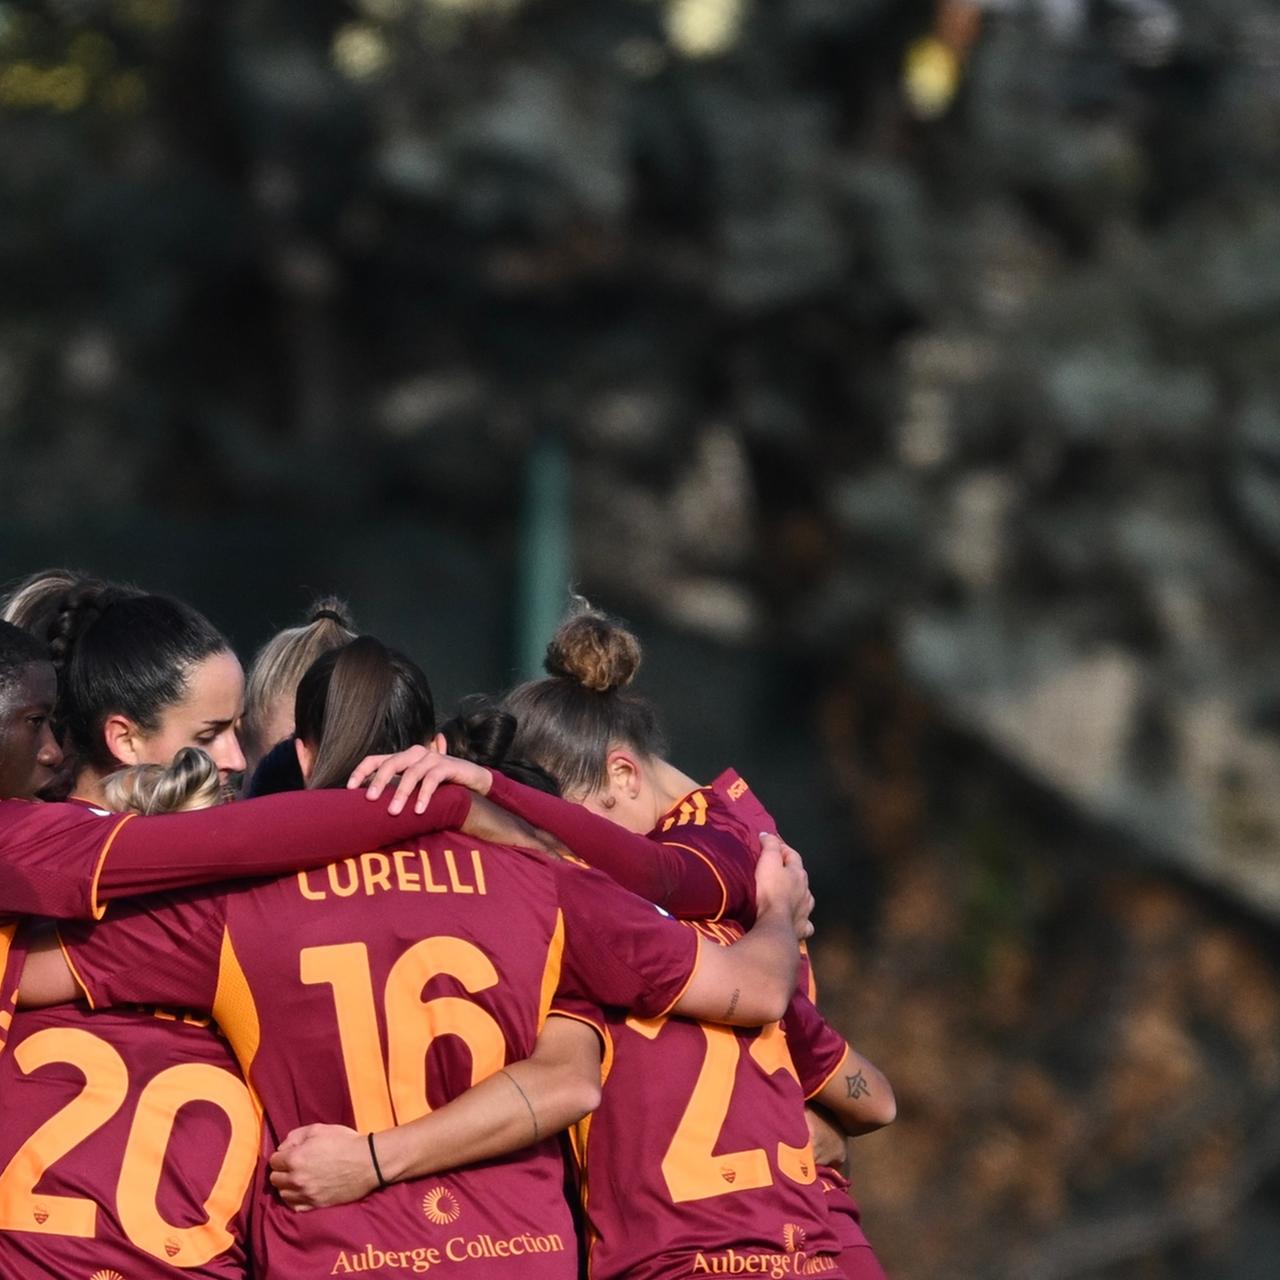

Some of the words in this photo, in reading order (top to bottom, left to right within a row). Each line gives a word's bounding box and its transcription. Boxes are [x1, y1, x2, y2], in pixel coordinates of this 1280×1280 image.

[299, 936, 506, 1135] 16
[330, 1244, 441, 1273] Auberge
[445, 1232, 565, 1262] Collection
[692, 1249, 791, 1280] Auberge
